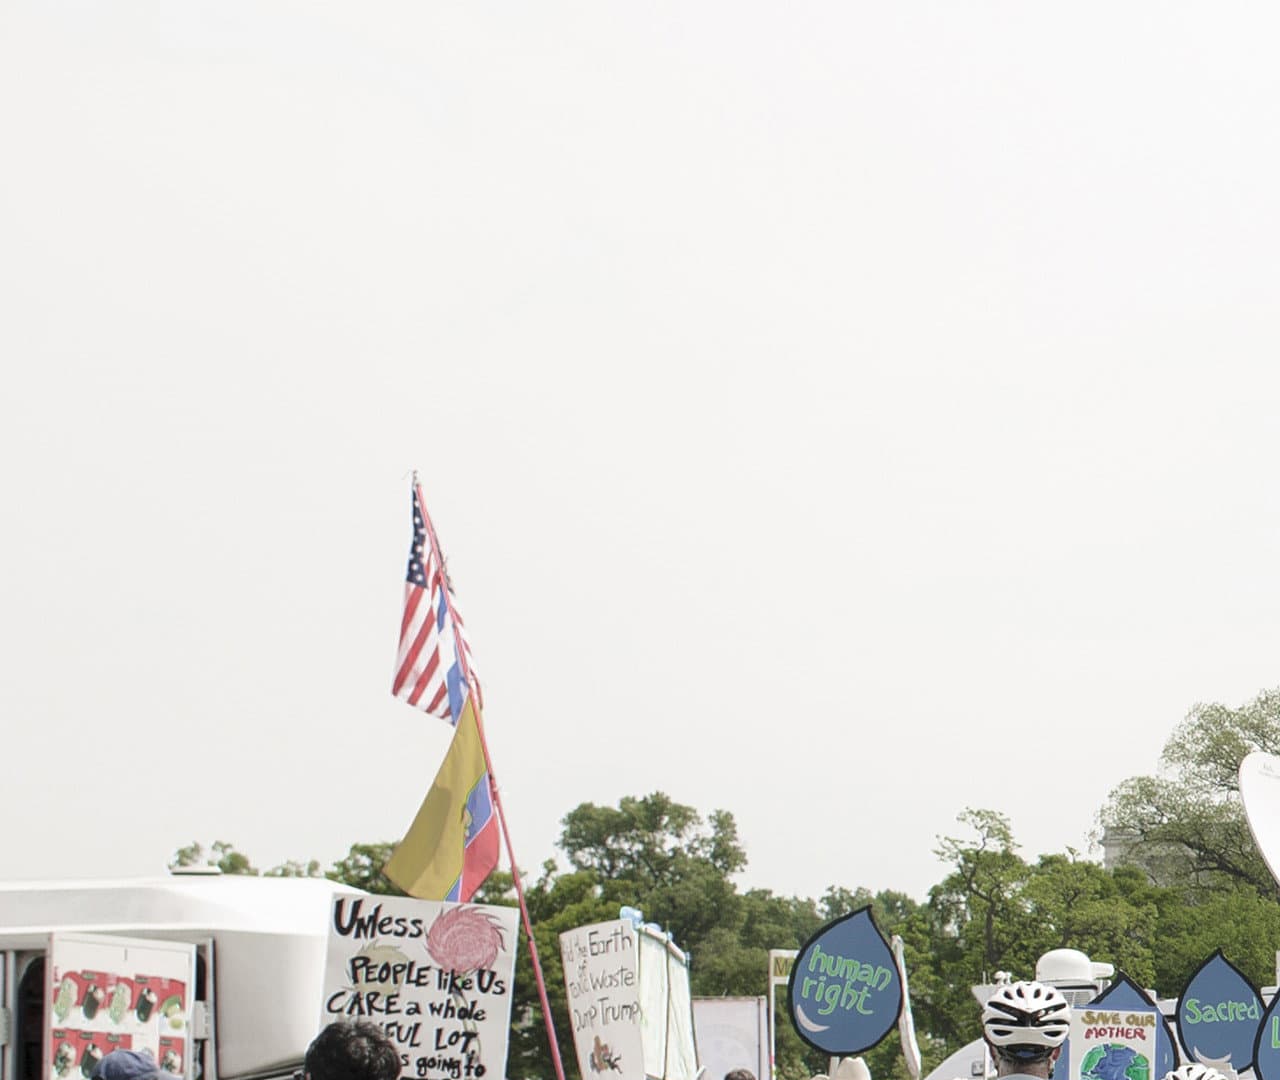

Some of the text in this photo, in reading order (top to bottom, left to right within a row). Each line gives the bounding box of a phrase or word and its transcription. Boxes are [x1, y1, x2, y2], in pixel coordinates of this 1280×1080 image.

[589, 926, 632, 957] Earth
[351, 957, 430, 987] PEOPLE
[437, 968, 473, 995] like
[589, 966, 634, 991] Waste
[808, 944, 892, 992] human
[327, 991, 487, 1022] CARE a whole
[801, 976, 874, 1016] right
[1184, 996, 1260, 1024] Sacred
[1081, 1011, 1155, 1028] SAVE OUR
[1085, 1027, 1146, 1040] MOTHER
[464, 1052, 487, 1078] to
